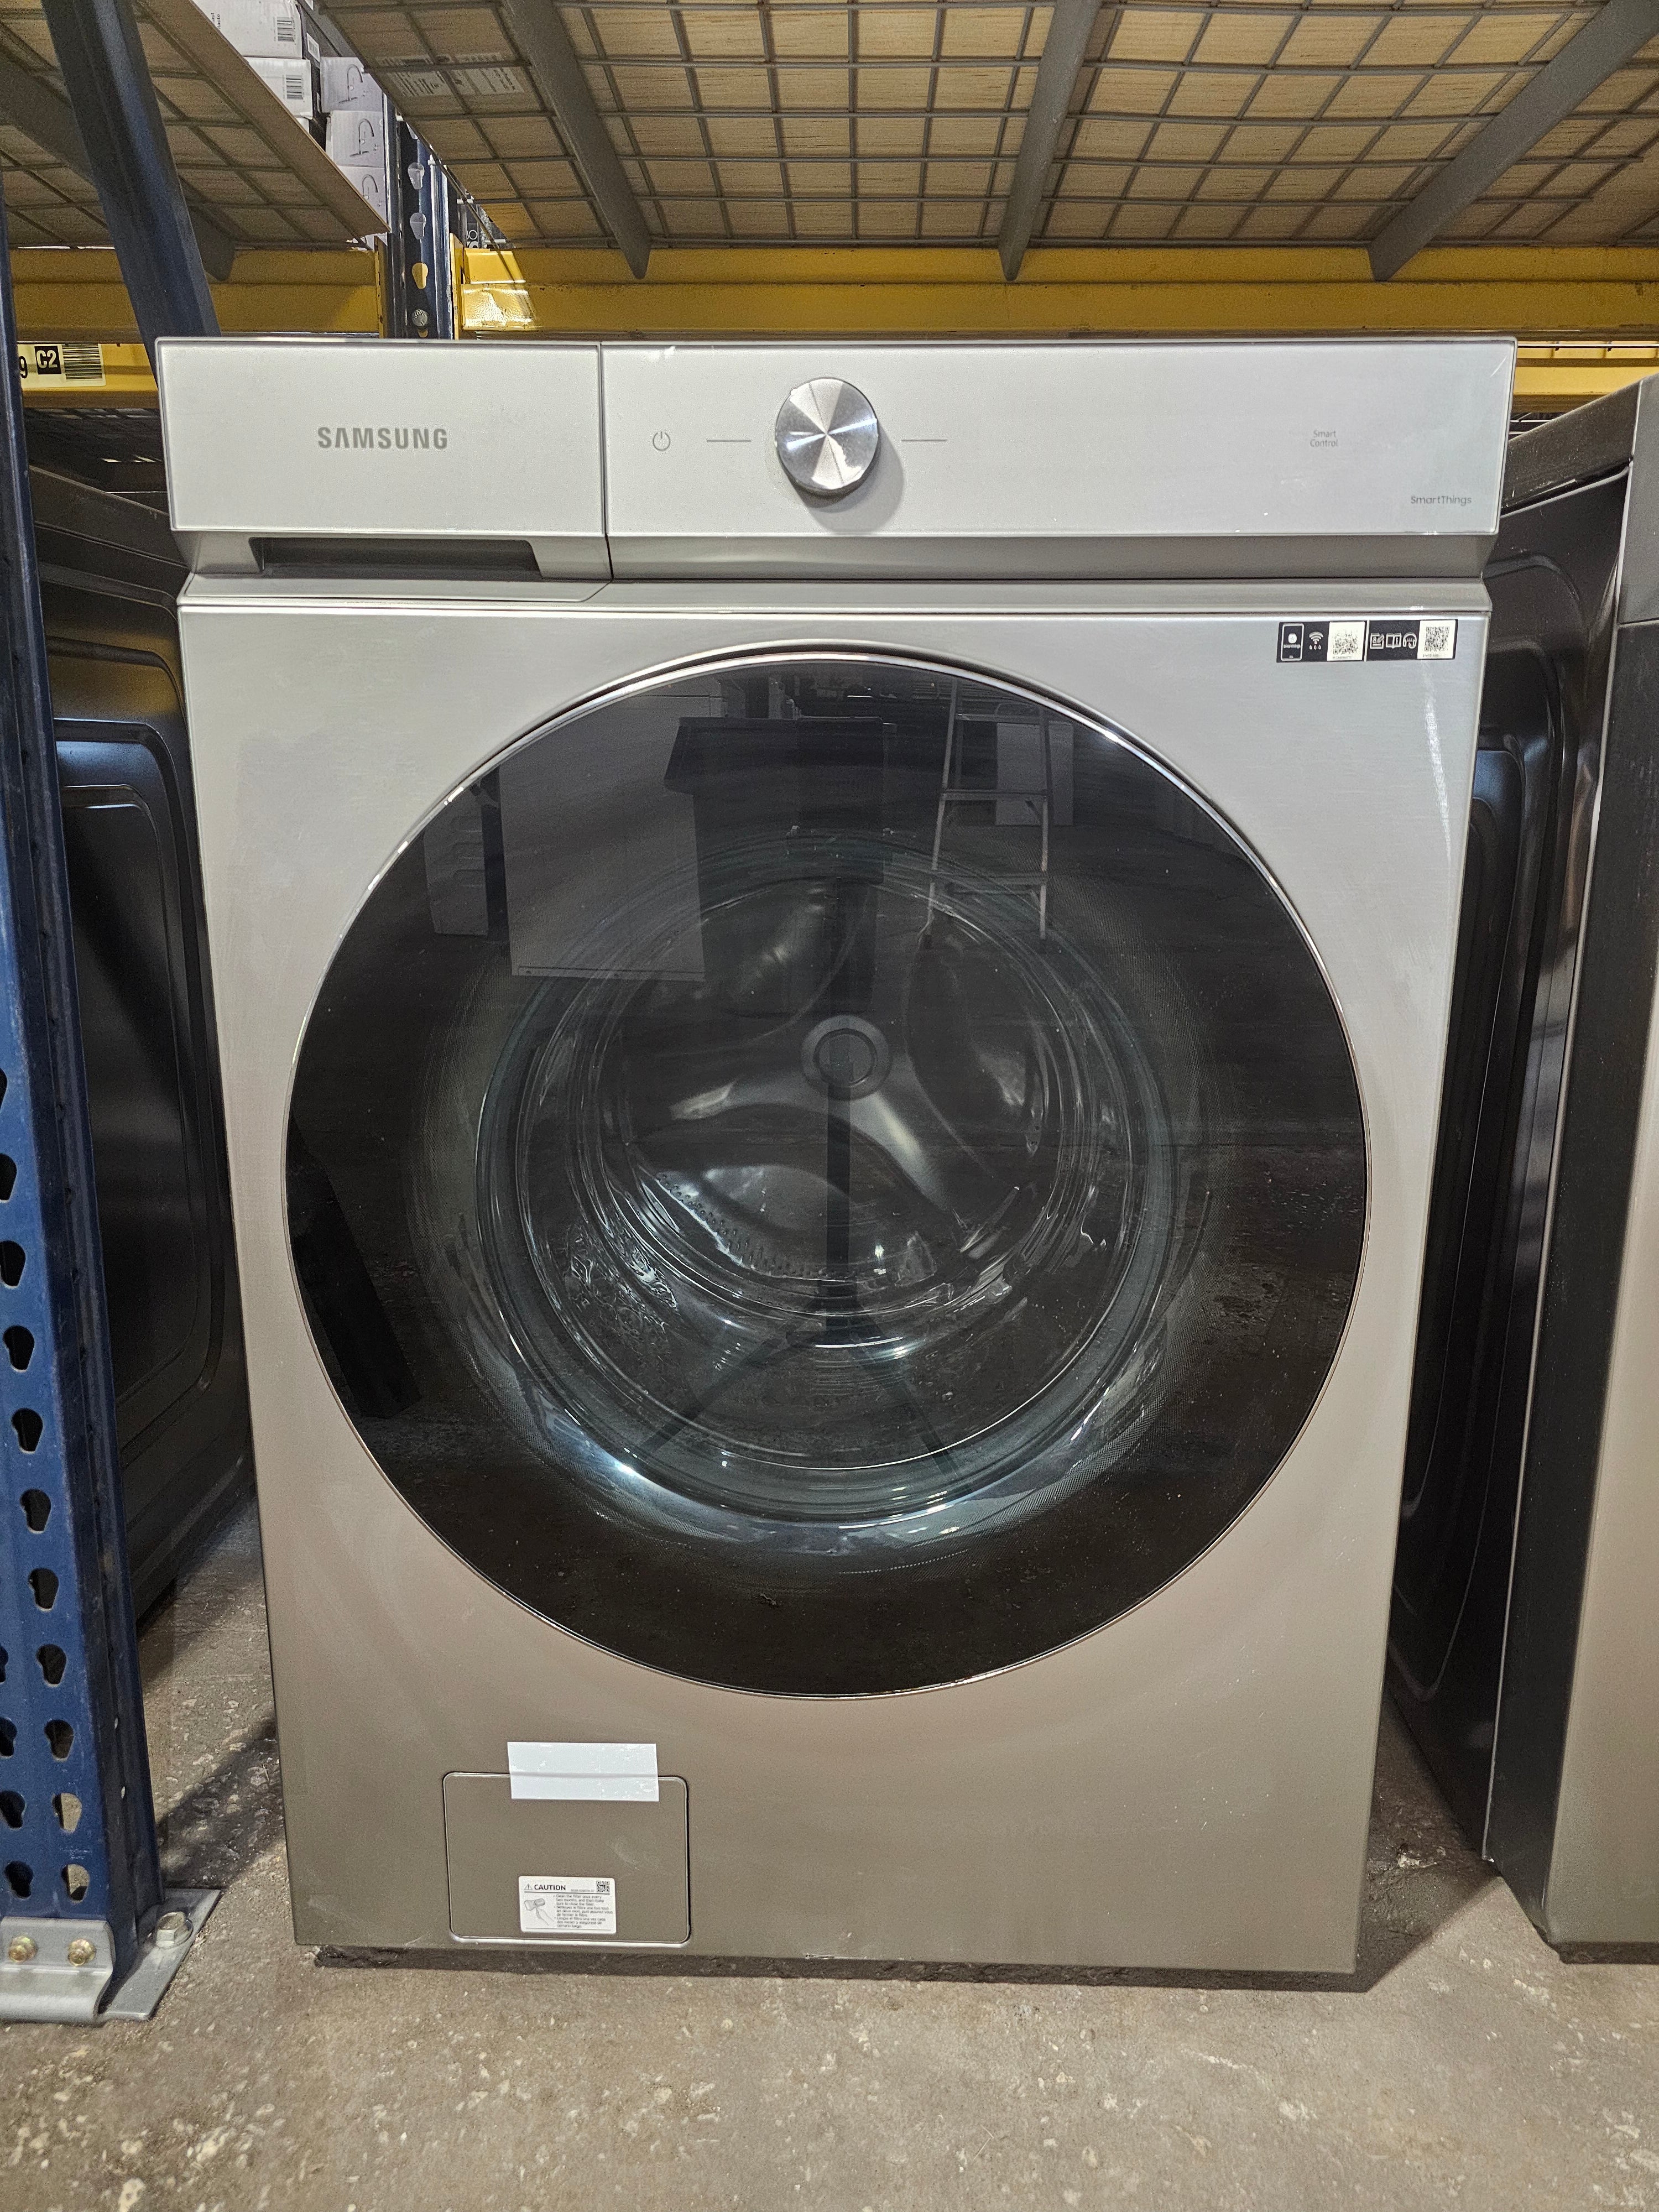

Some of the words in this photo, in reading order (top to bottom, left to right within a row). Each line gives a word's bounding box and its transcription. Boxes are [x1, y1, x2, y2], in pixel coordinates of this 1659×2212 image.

[36, 349, 58, 369] C2
[317, 426, 447, 450] SAMSUNG
[1411, 495, 1472, 506] SmartThings
